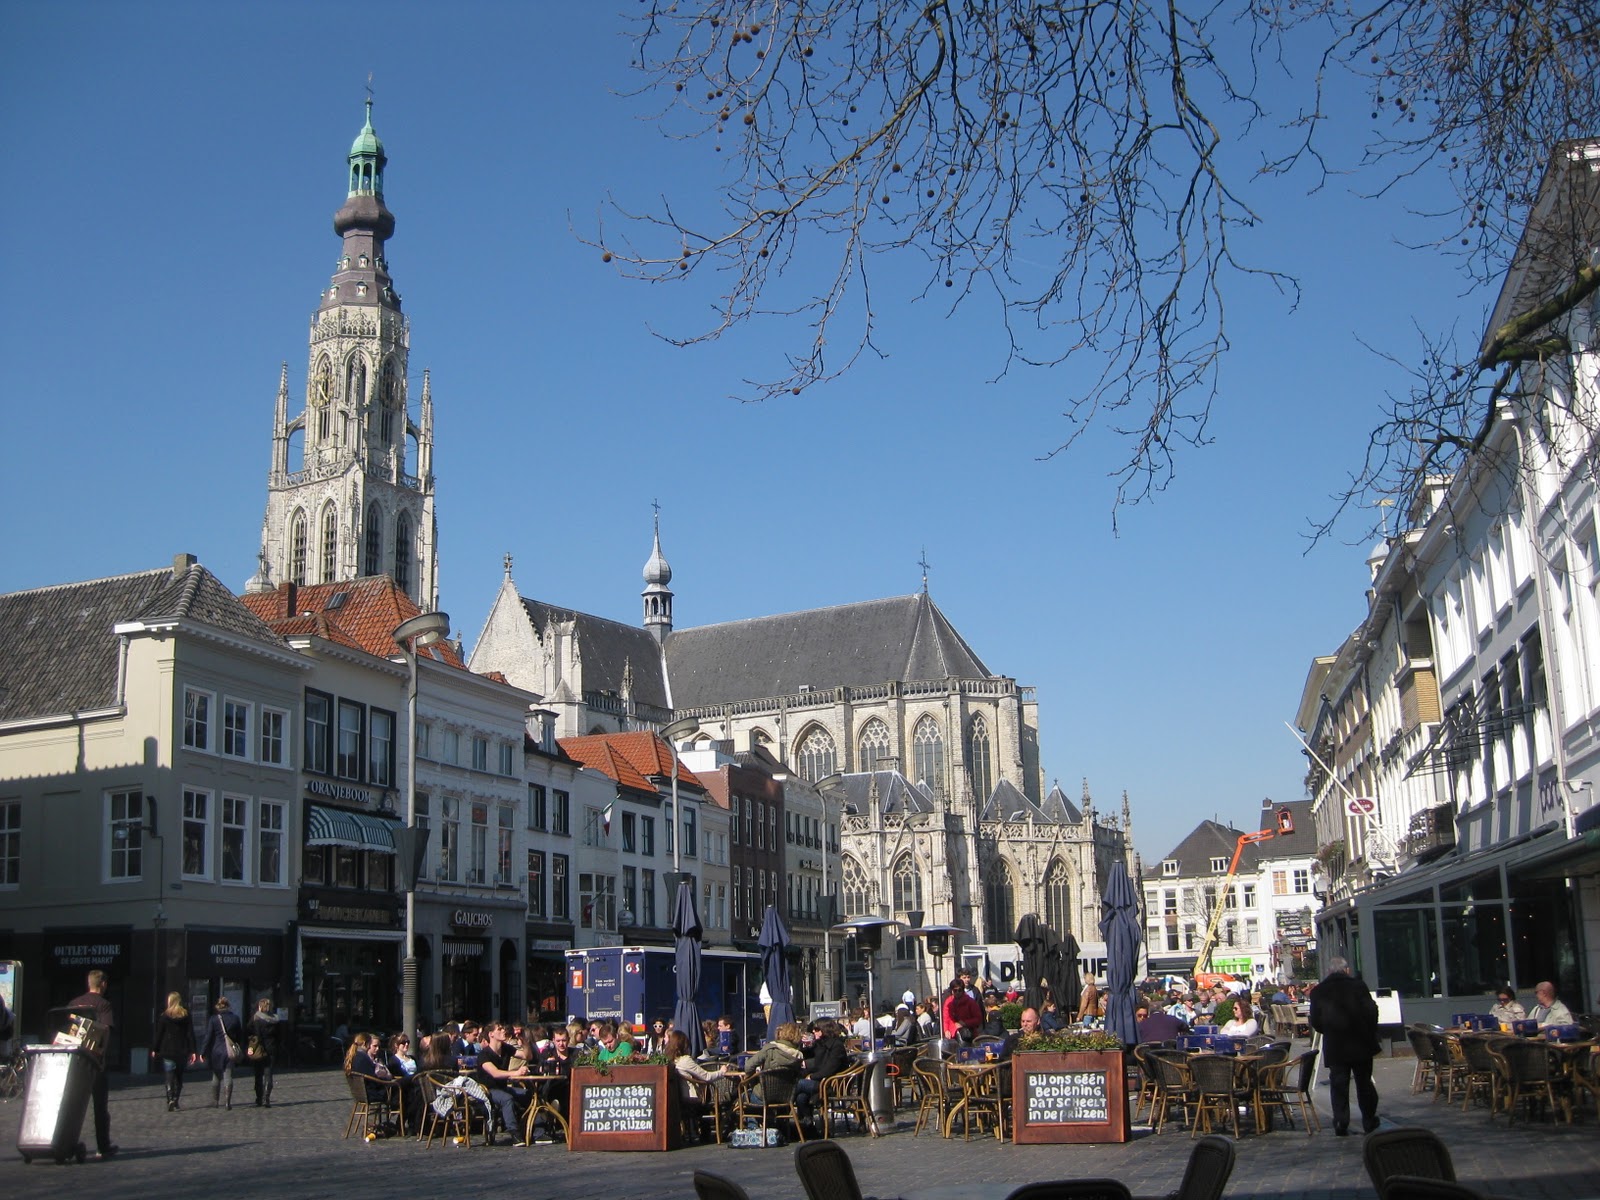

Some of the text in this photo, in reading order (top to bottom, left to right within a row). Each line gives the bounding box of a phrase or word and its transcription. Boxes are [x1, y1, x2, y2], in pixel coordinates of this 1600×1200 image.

[311, 780, 371, 803] ORANJEBOOM
[455, 909, 493, 926] GAUCHOS
[91, 956, 113, 964] MARKT
[215, 956, 257, 965] DE GROTE MARKT
